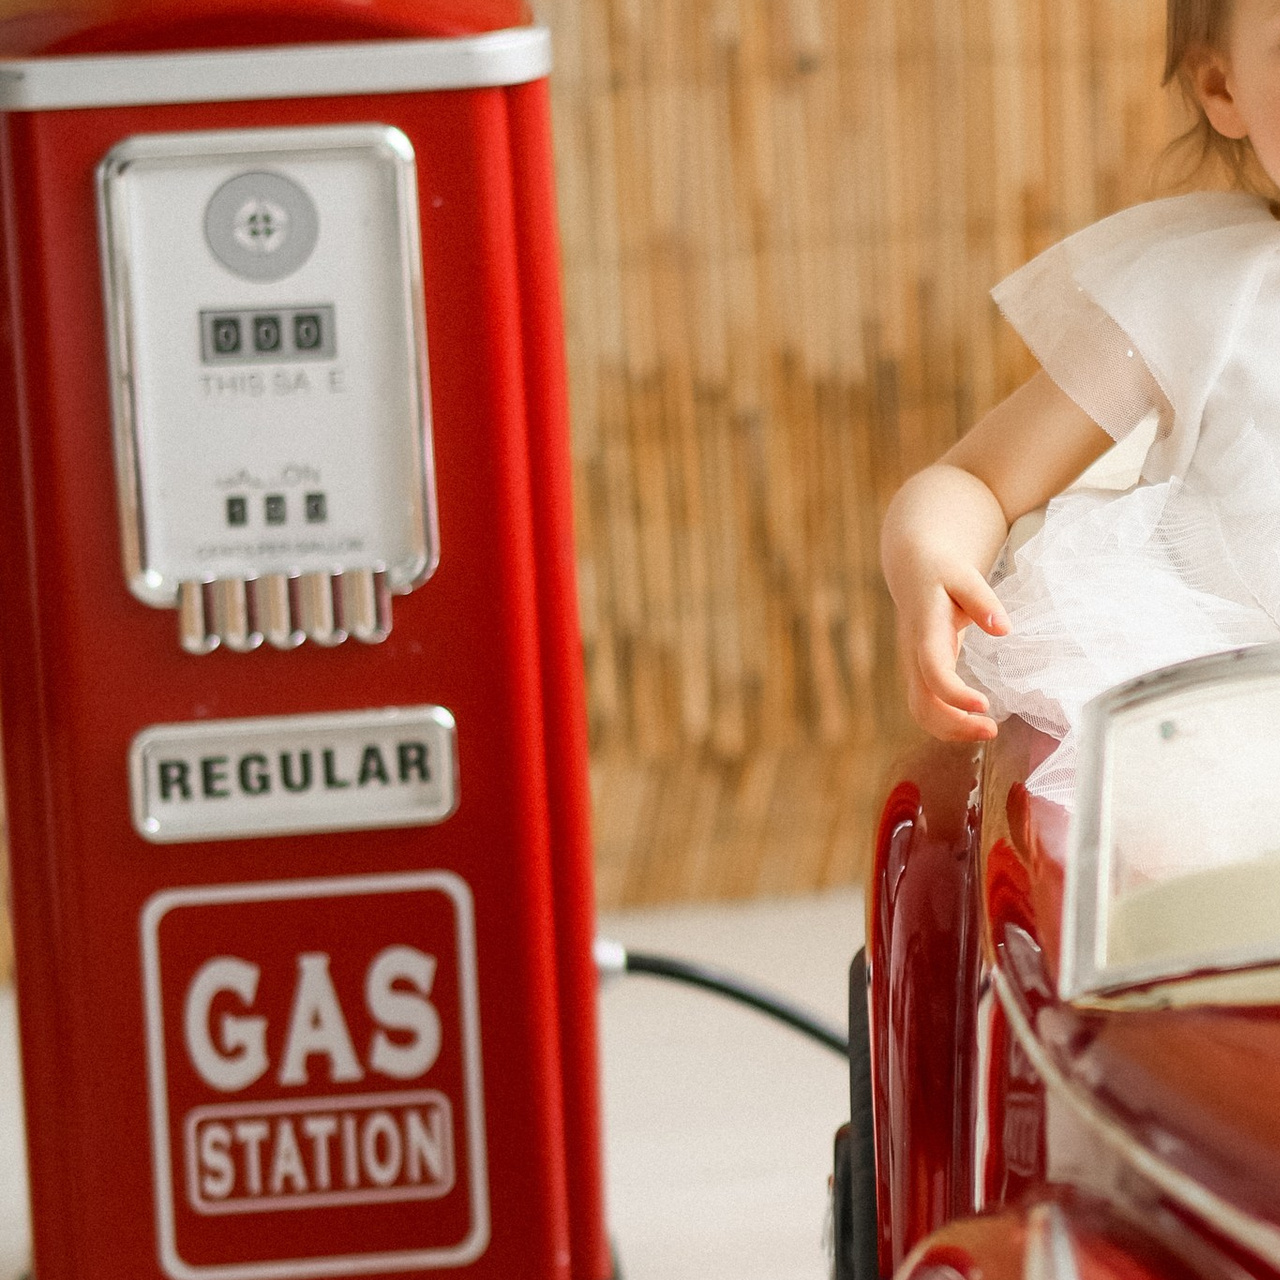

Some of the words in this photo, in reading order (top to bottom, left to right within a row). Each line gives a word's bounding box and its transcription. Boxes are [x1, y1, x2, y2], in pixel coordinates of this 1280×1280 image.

[200, 373, 265, 399] THIS
[273, 368, 345, 397] SAE
[158, 741, 432, 801] REGULAR
[184, 944, 442, 1091] GAS
[199, 1109, 444, 1198] STATION
